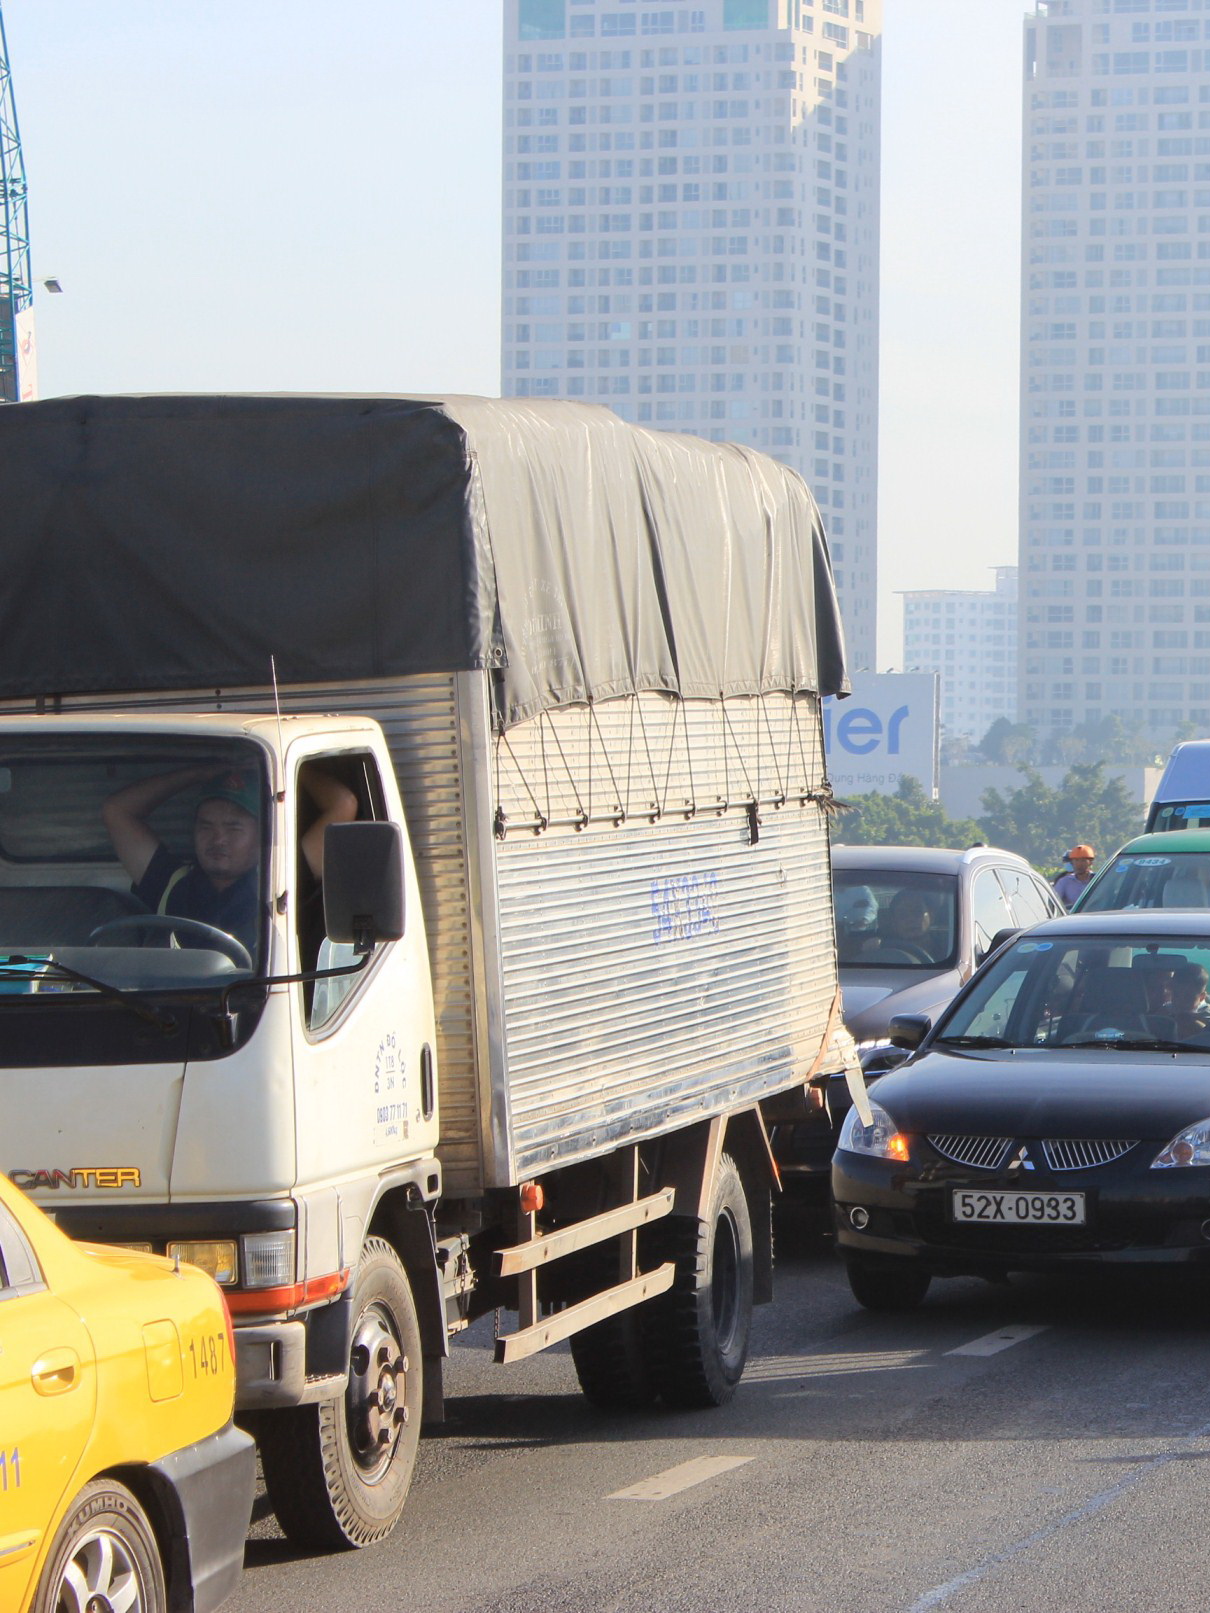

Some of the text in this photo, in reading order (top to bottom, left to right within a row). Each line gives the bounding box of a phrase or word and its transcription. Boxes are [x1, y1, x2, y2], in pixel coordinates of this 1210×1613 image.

[8, 1167, 142, 1190] CANTER
[961, 1194, 1077, 1221] 52X-0933
[189, 1332, 225, 1379] 1487
[66, 1495, 128, 1538] KUMHO
